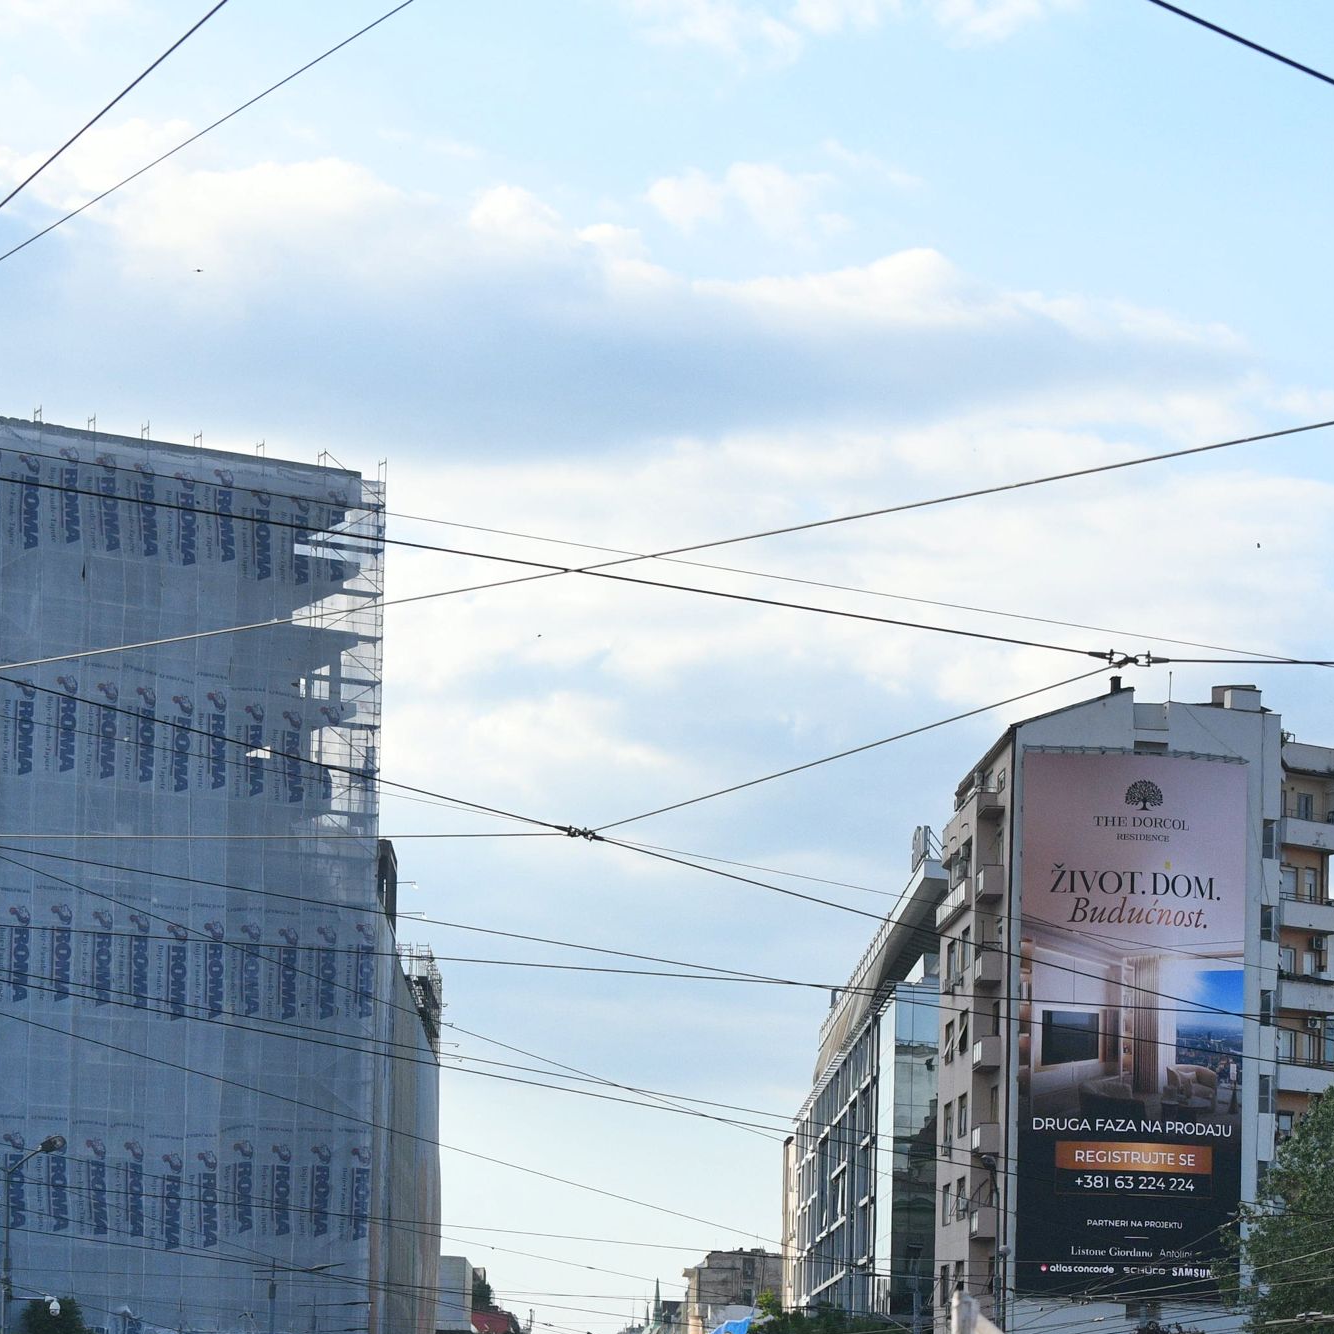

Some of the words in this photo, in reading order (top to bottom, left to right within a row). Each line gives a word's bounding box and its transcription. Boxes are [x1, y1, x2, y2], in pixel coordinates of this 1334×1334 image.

[24, 475, 39, 549] ROMA
[63, 469, 80, 544] ROMA
[102, 477, 120, 551] ROMA
[140, 483, 157, 556] ROMA
[180, 491, 196, 566] ROMA
[218, 491, 234, 562] ROMA
[255, 509, 271, 580] ROMA
[18, 701, 35, 775] ROMA
[59, 697, 77, 772] ROMA
[100, 704, 117, 779] ROMA
[139, 708, 156, 783] ROMA
[174, 716, 191, 792] ROMA
[212, 714, 226, 789] ROMA
[286, 732, 303, 802] ROMA
[1093, 816, 1127, 827] THE
[1132, 817, 1190, 831] DORCOL
[1116, 833, 1170, 842] RESIDENCE
[1050, 863, 1146, 895] ŽIVOT.
[1151, 872, 1221, 901] DOM.
[1067, 897, 1207, 929] Budućnost.
[13, 928, 30, 1002] ROMA
[54, 927, 71, 1001] ROMA
[96, 933, 111, 1007] ROMA
[133, 936, 149, 1009] ROMA
[170, 945, 187, 1020] ROMA
[208, 944, 224, 1019] ROMA
[245, 945, 260, 1016] ROMA
[281, 948, 296, 1020] ROMA
[321, 948, 336, 1020] ROMA
[359, 944, 374, 1018] ROMA
[1032, 1117, 1091, 1131] DRUGA
[1095, 1119, 1137, 1132] FAZA
[1141, 1120, 1162, 1133] NA
[1166, 1121, 1232, 1138] PRODAJU
[1075, 1150, 1175, 1166] REGISTRUJTE
[1179, 1154, 1195, 1166] SE
[50, 1156, 67, 1232] ROMA
[90, 1161, 108, 1234] ROMA
[130, 1162, 144, 1237] ROMA
[166, 1175, 181, 1249] ROMA
[203, 1173, 217, 1248] ROMA
[238, 1162, 253, 1233] ROMA
[275, 1165, 290, 1235] ROMA
[314, 1166, 330, 1237] ROMA
[1074, 1175, 1109, 1189] +381
[1115, 1176, 1134, 1189] 63
[1138, 1176, 1166, 1190] 224
[1169, 1178, 1195, 1192] 224
[1071, 1245, 1106, 1257] Listone
[1108, 1247, 1153, 1258] Giordano
[1087, 1219, 1128, 1227] PARTNERI
[1130, 1220, 1143, 1228] NA
[1144, 1221, 1183, 1230] PROJEKTU
[1049, 1264, 1072, 1273] atlas
[1073, 1265, 1115, 1274] concorde
[1172, 1267, 1212, 1278] SAMSUN
